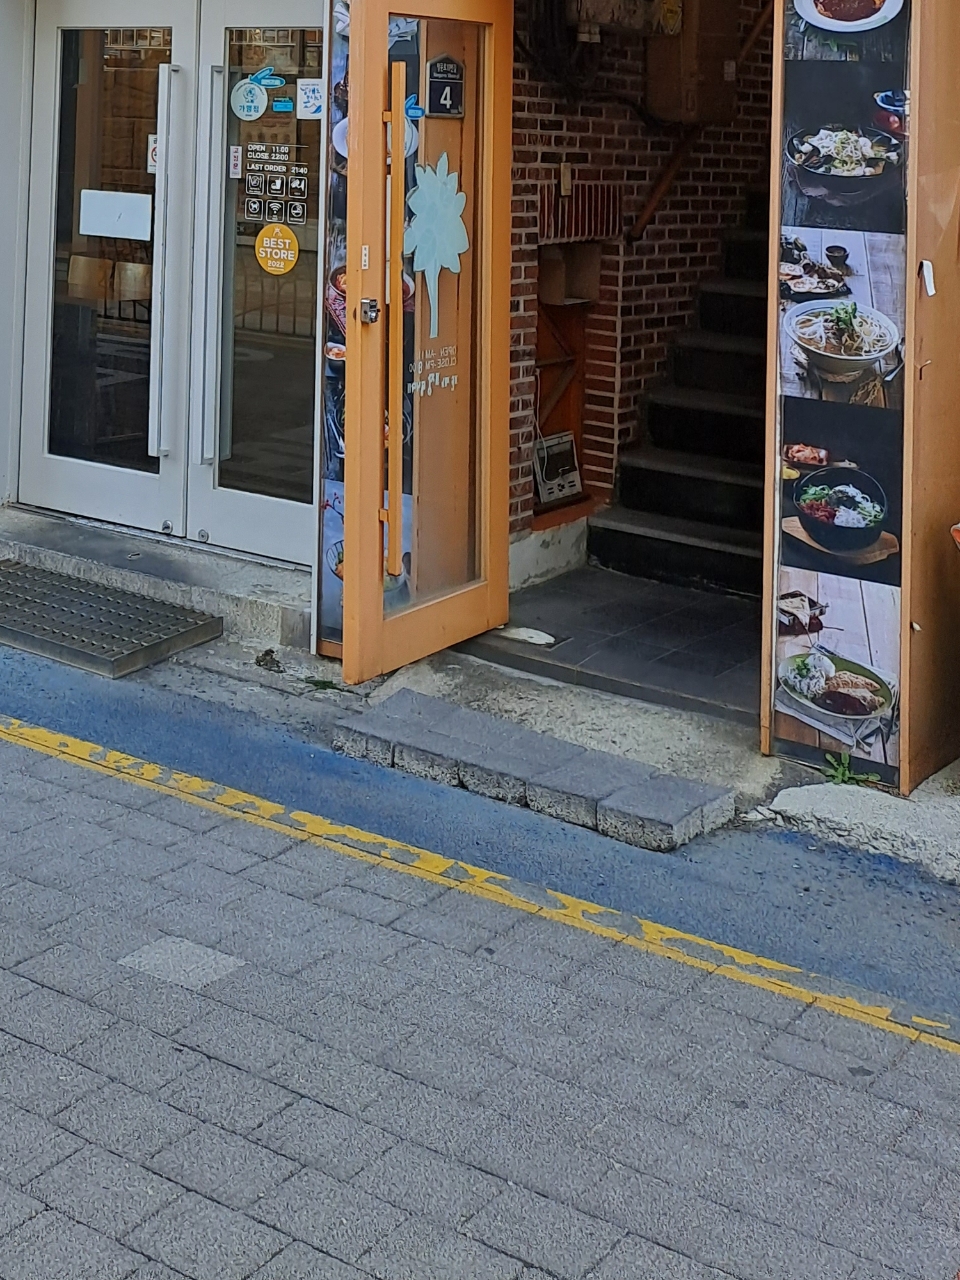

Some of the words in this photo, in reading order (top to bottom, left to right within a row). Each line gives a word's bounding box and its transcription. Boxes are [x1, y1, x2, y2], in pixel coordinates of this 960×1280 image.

[439, 85, 453, 109] 4
[248, 144, 266, 152] OPEN
[247, 163, 263, 171] LAST
[291, 166, 308, 174] 21:40
[263, 237, 291, 249] BEST
[258, 247, 295, 261] STORE
[267, 260, 285, 268] 2022
